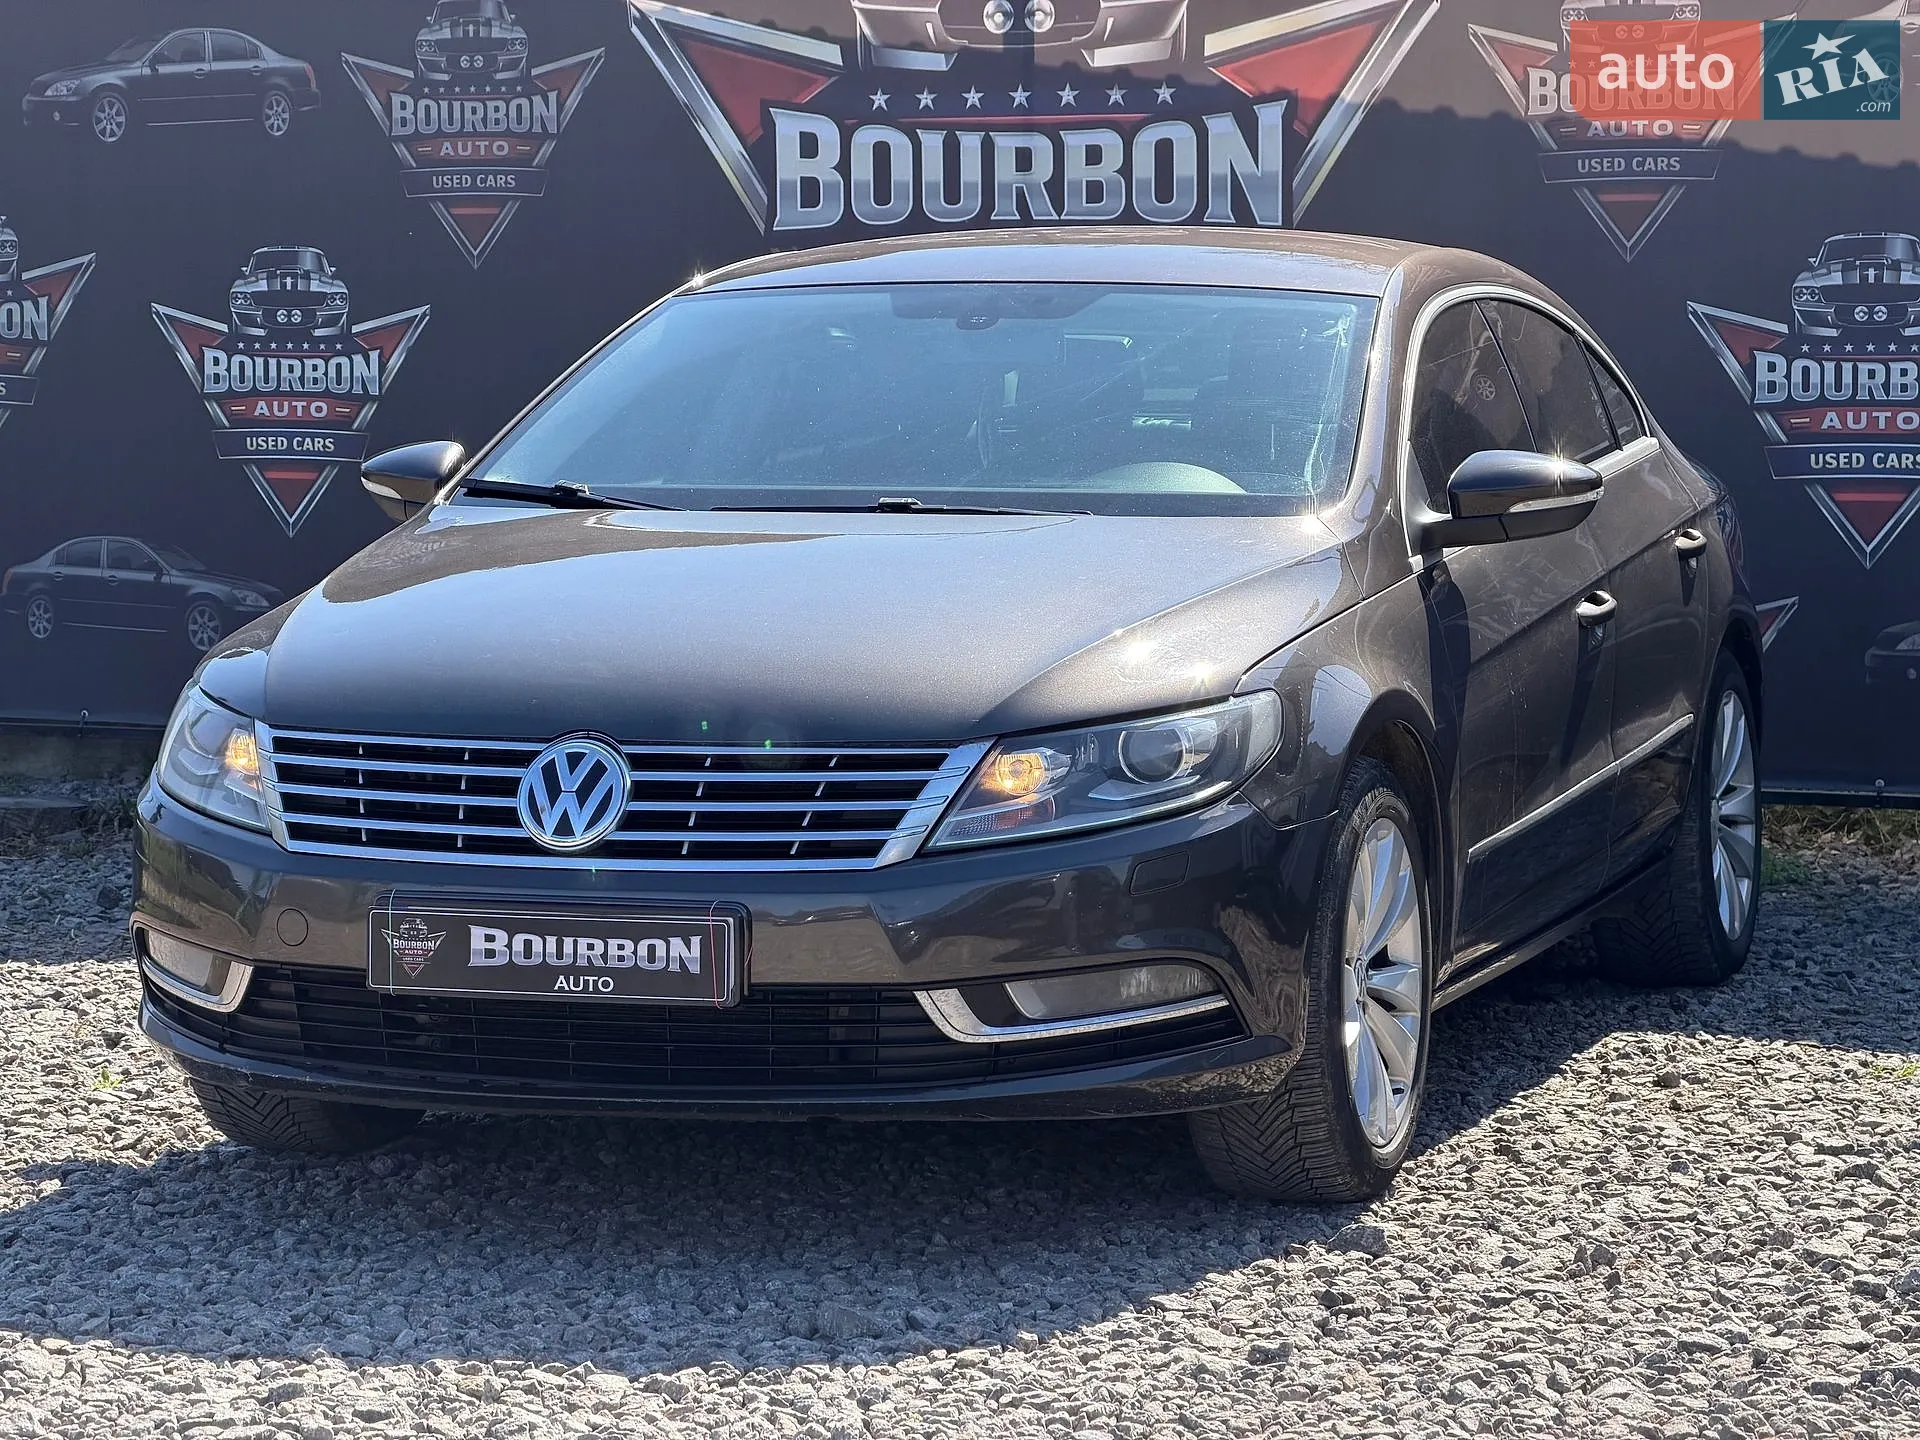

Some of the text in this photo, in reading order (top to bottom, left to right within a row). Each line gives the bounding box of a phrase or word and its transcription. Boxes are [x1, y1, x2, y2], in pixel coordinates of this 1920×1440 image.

[1527, 63, 1736, 116] BOURBON
[389, 90, 558, 136] BOURBON
[1587, 119, 1674, 137] AUTO
[440, 141, 509, 156] AUTO
[769, 99, 1288, 231] BOURBON
[1577, 156, 1681, 173] USED CARS
[432, 174, 516, 188] USED CARS
[202, 347, 381, 396] BOURBON
[253, 400, 328, 418] AUTO
[1821, 411, 1920, 430] AUTO
[246, 436, 335, 452] USED CARS
[1810, 452, 1865, 469] USED
[393, 939, 434, 950] BOURBON
[467, 924, 703, 974] BOURBON
[553, 974, 614, 993] AUTO
